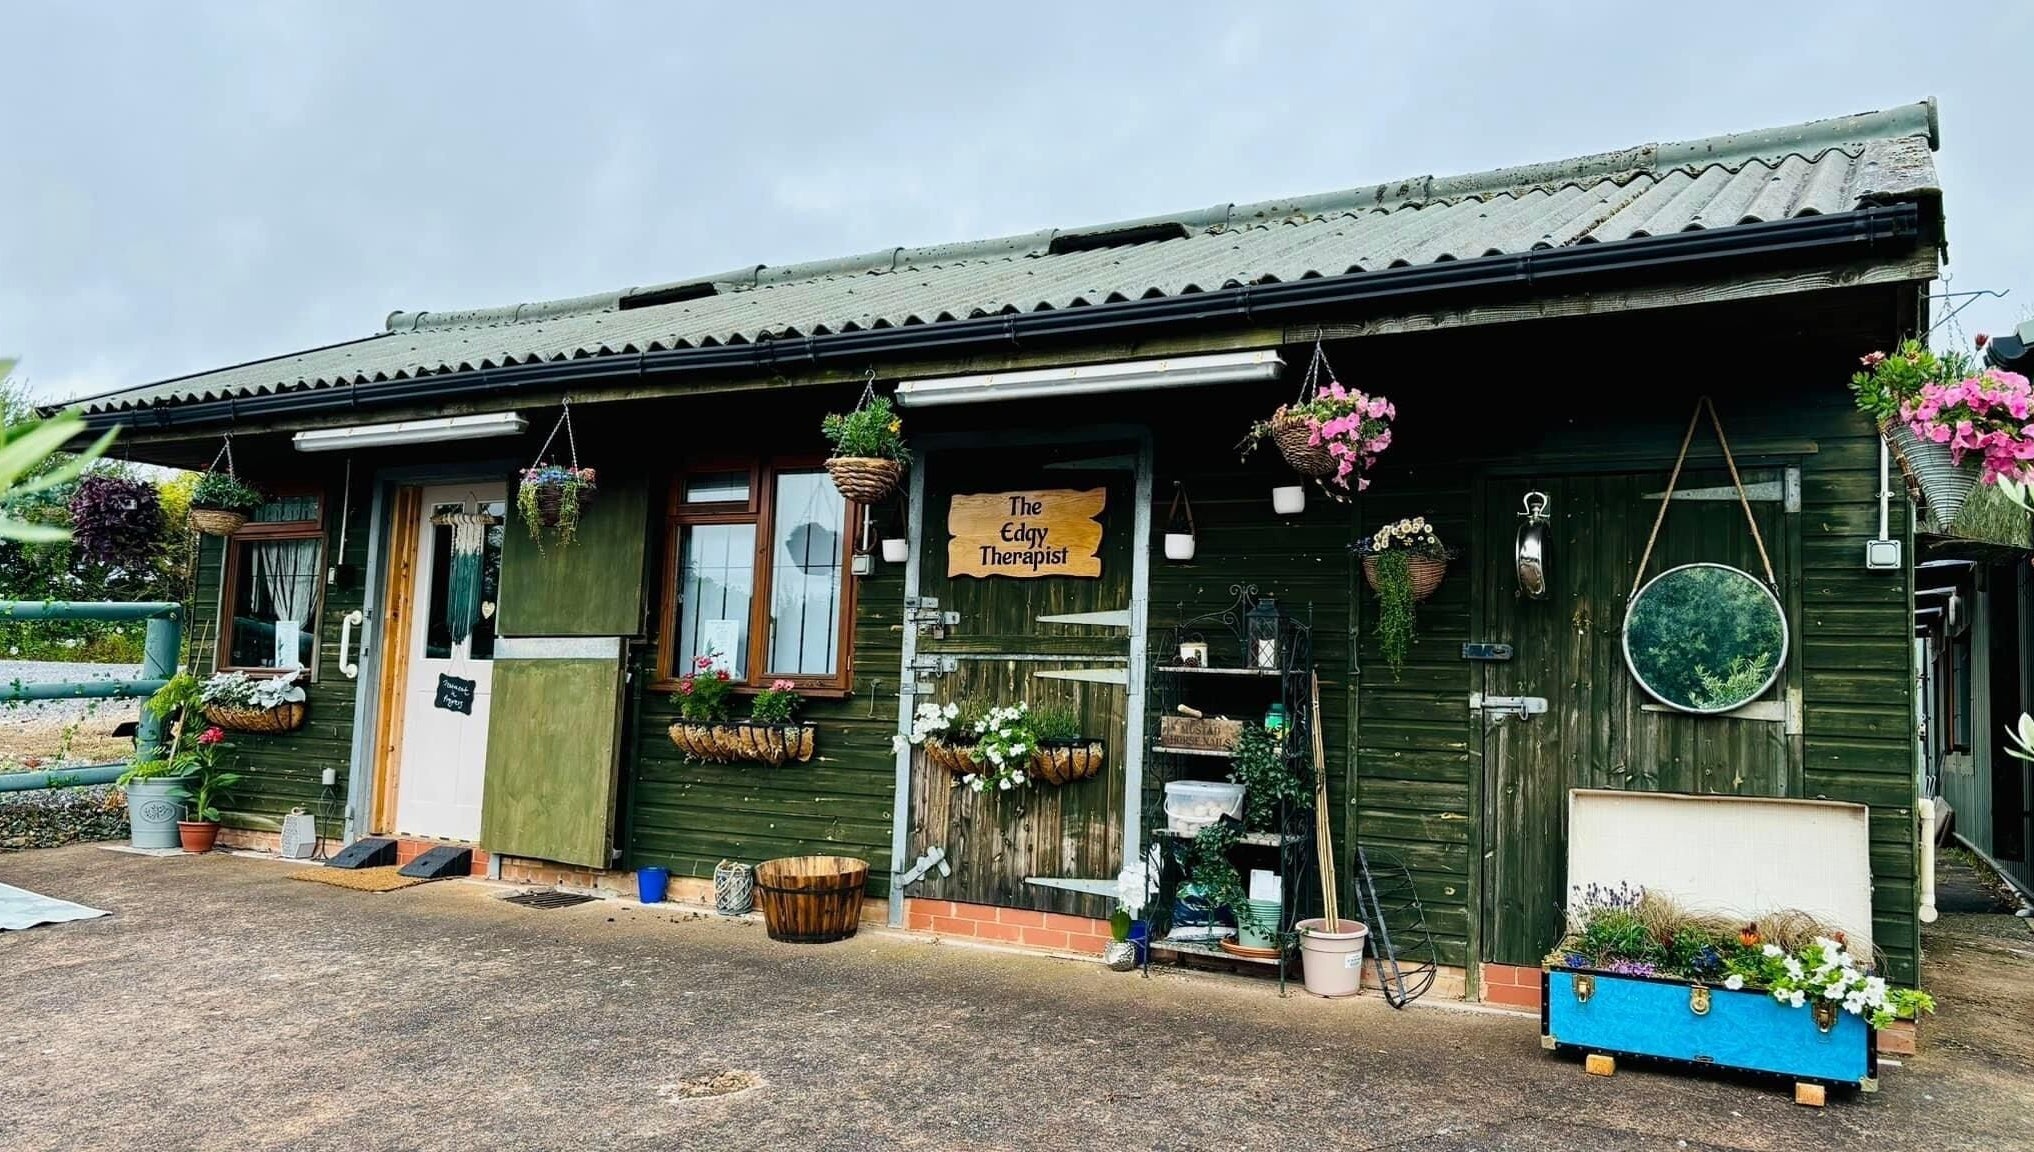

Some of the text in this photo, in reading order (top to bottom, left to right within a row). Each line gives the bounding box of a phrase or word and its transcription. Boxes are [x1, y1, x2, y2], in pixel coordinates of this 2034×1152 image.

[1009, 496, 1042, 516] The
[1000, 522, 1049, 550] Edgy
[979, 546, 1069, 572] Therapist
